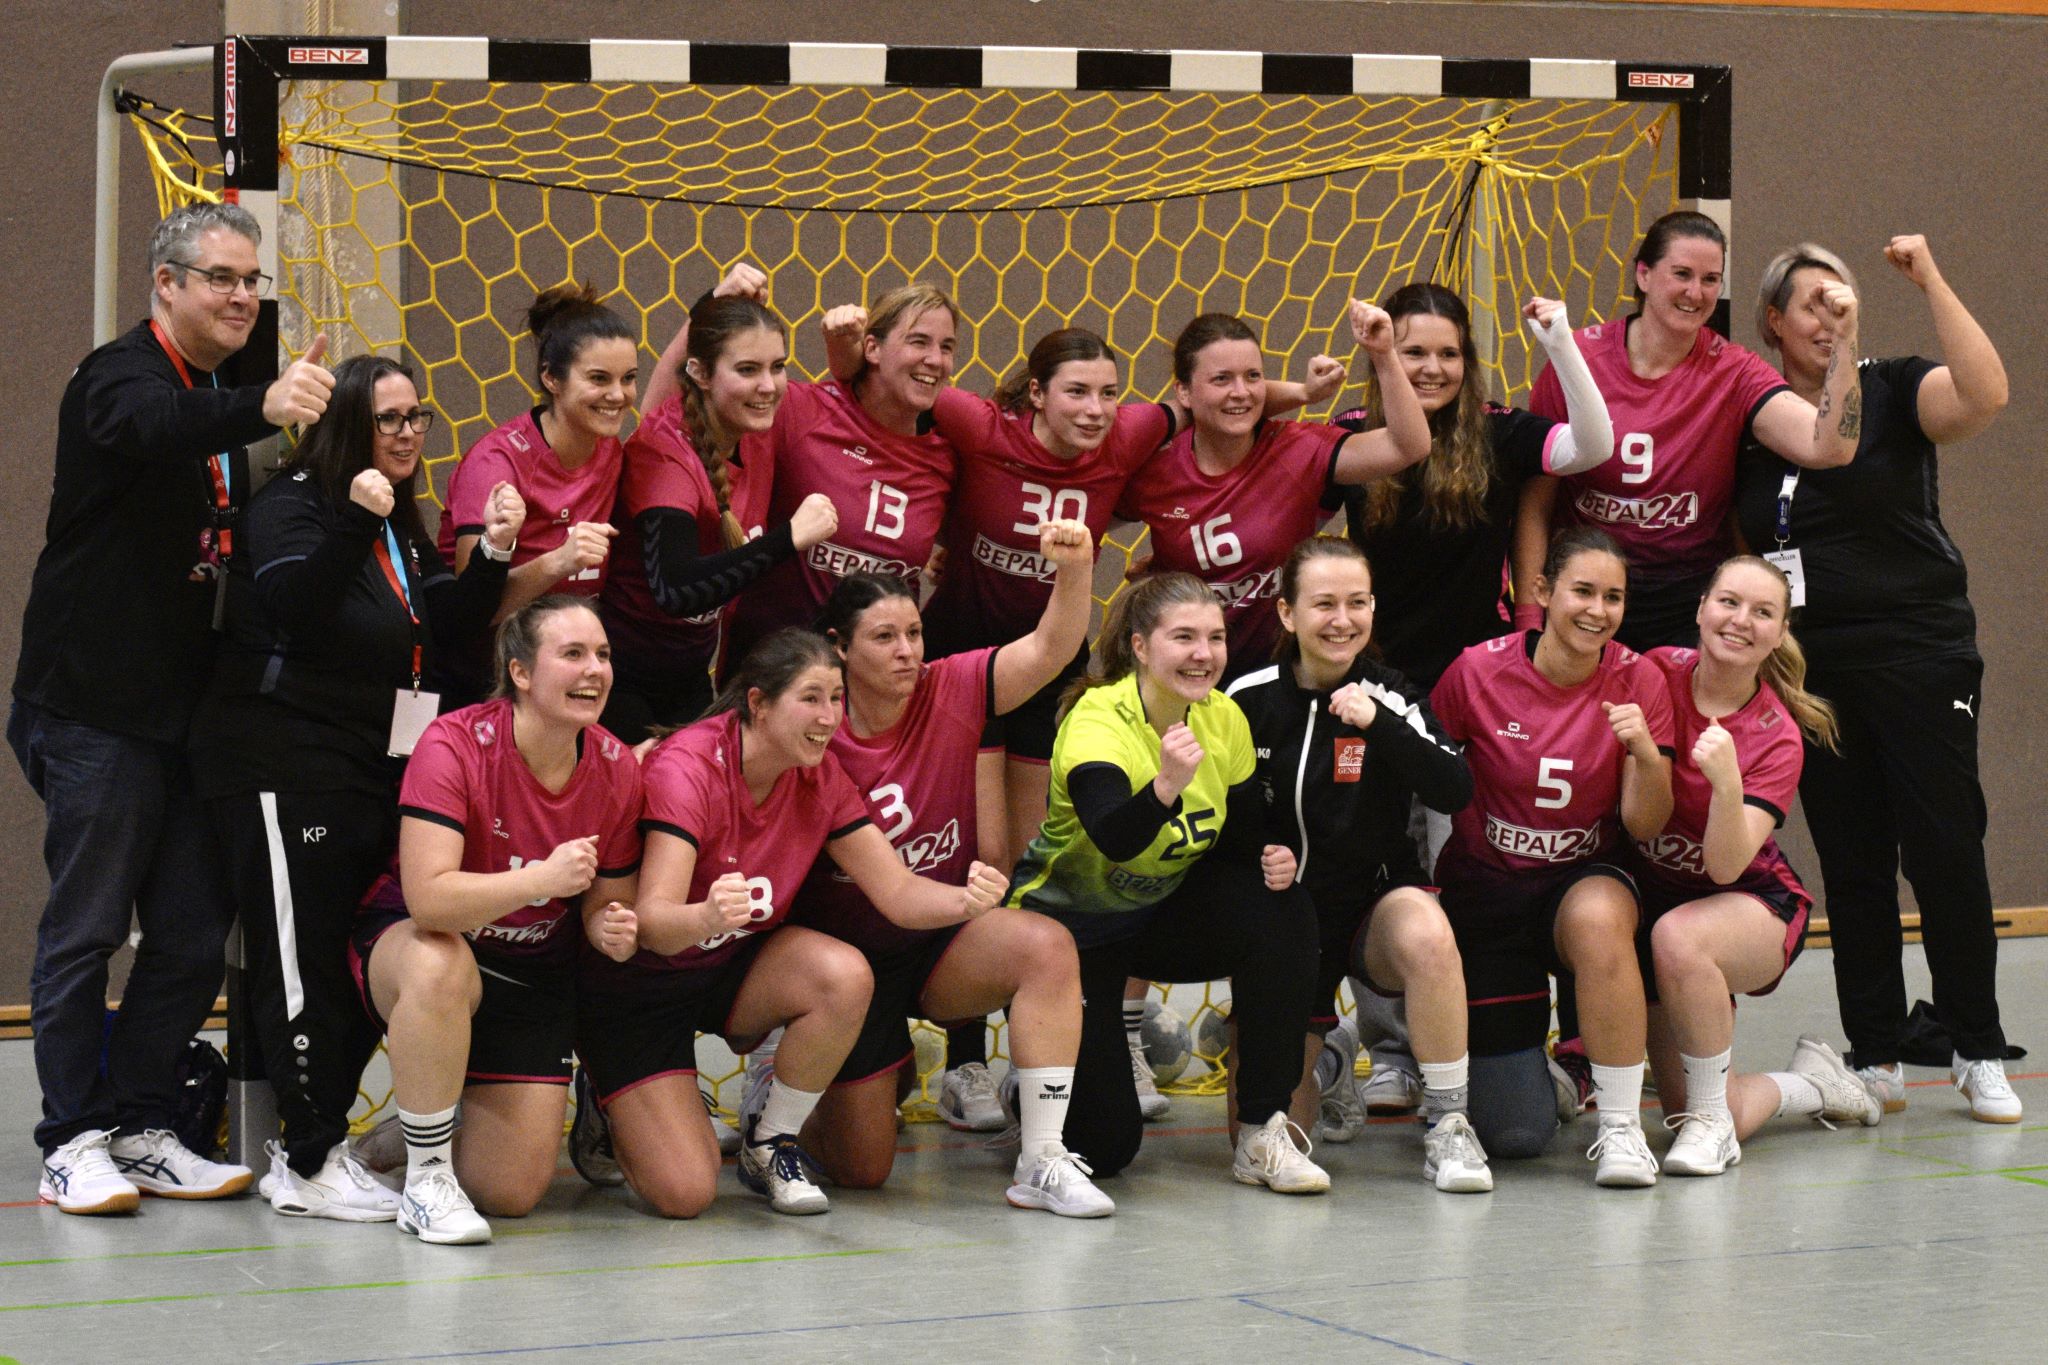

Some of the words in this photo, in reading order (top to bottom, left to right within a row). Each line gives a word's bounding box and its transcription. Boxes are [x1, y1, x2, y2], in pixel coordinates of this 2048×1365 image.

[290, 49, 363, 63] BENZ
[1629, 73, 1689, 87] BENZ
[226, 42, 235, 134] BENZ
[1620, 432, 1654, 484] 9
[864, 479, 909, 540] 13
[1012, 481, 1088, 536] 30
[1578, 491, 1694, 527] BEPAL24
[976, 540, 1057, 583] BEPAL
[1190, 513, 1243, 571] 16
[1534, 757, 1574, 810] 5
[302, 826, 328, 844] KP
[869, 783, 914, 842] 3
[1158, 807, 1216, 861] 25
[1487, 820, 1600, 861] BEPAL24
[1039, 1091, 1069, 1100] erima
